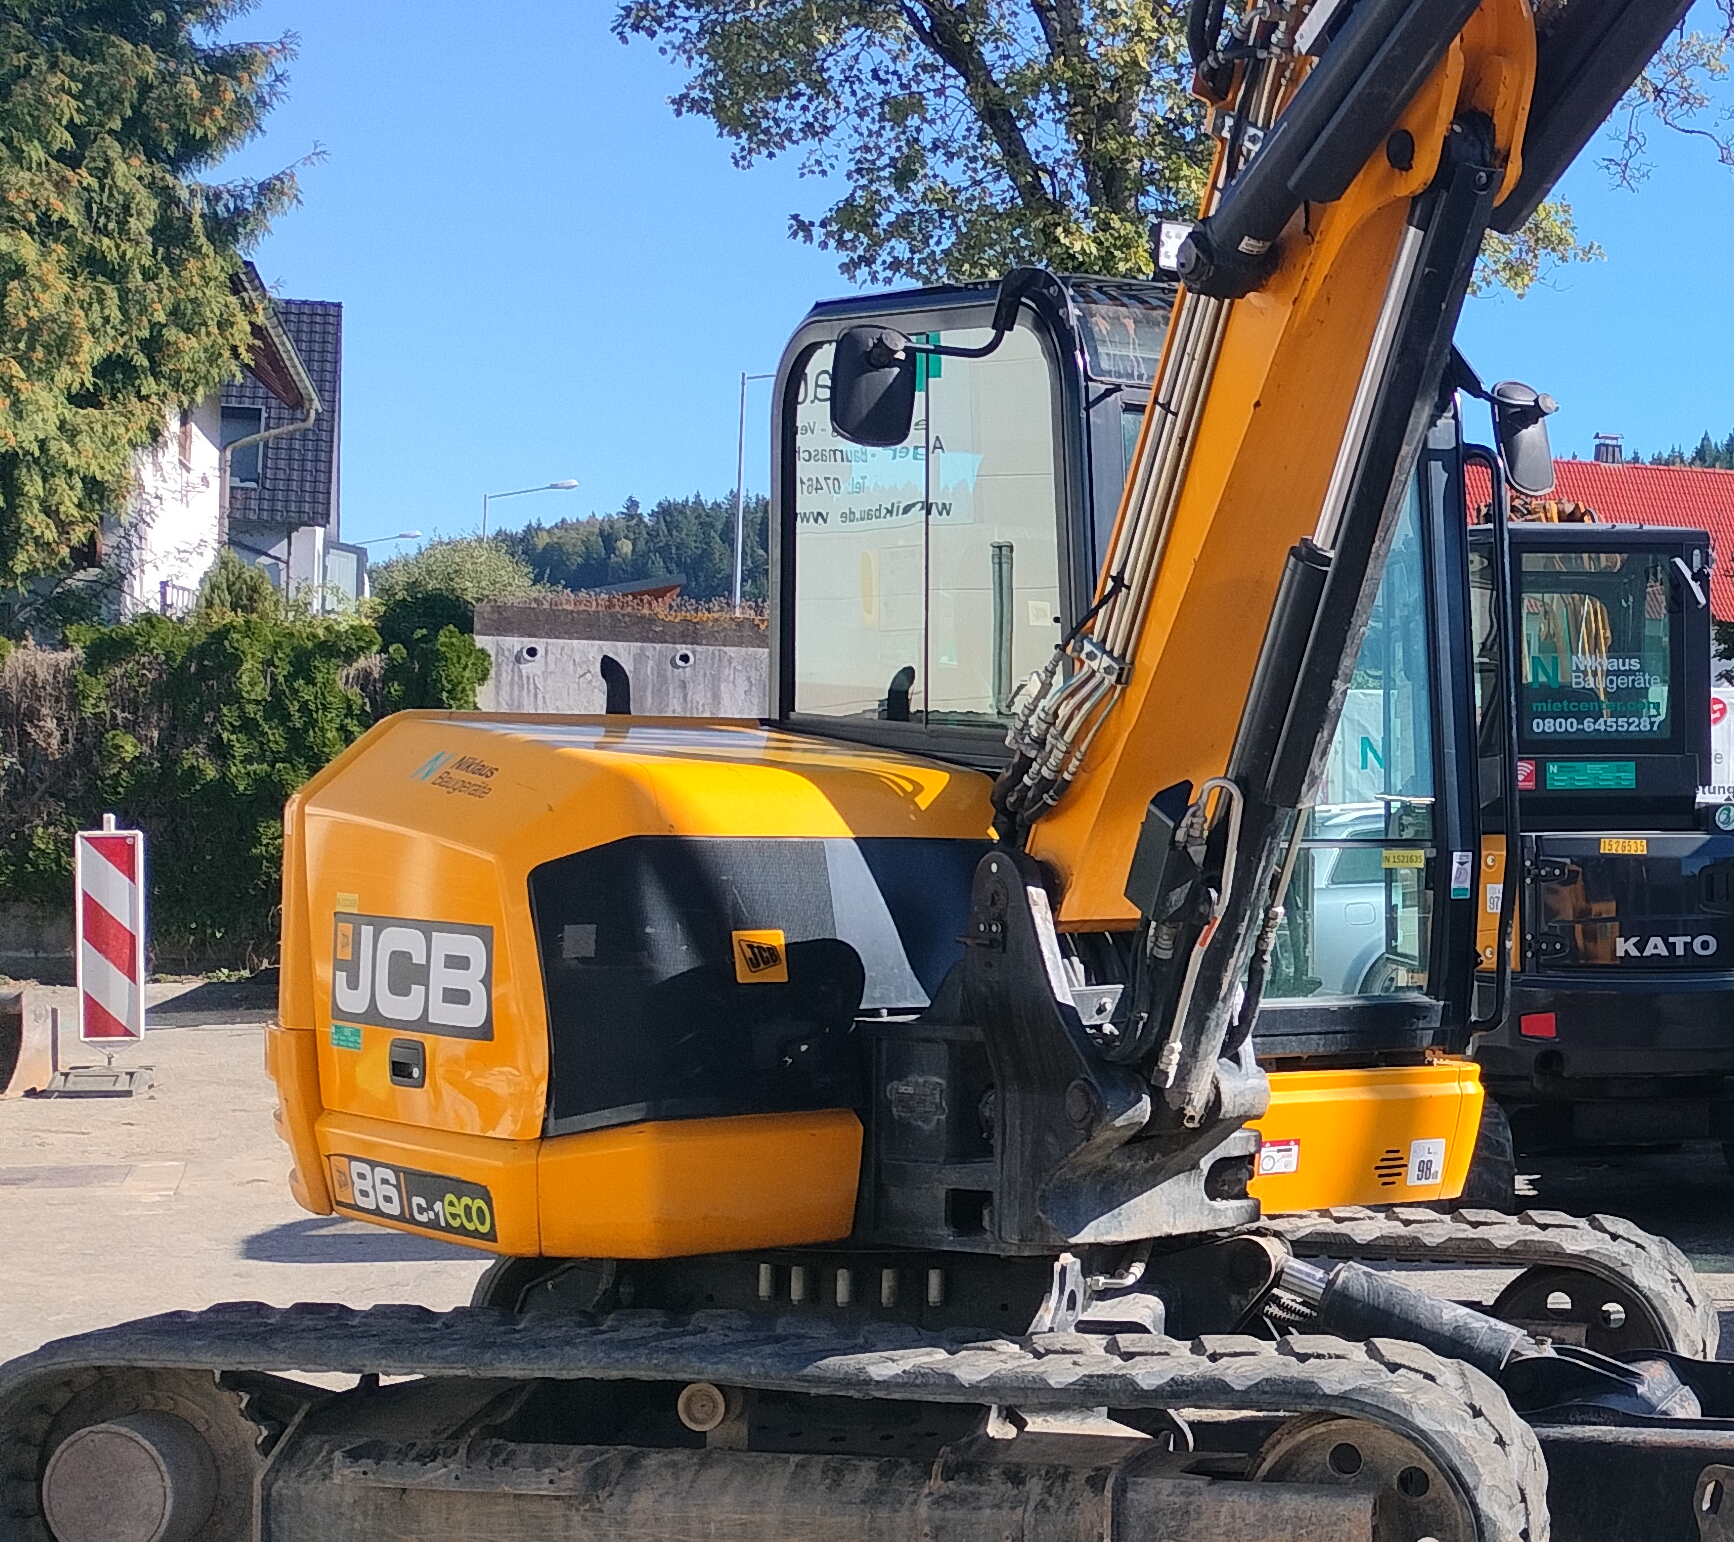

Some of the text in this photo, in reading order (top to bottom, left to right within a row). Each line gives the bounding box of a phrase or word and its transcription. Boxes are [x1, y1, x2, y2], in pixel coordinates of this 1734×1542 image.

[1571, 654, 1641, 671] Niklaus
[1571, 672, 1661, 693] Baugeräte
[1532, 717, 1660, 734] 0800-6455287
[450, 755, 499, 779] Niklaus
[430, 770, 492, 799] Baugeräte
[1602, 840, 1646, 853] 1526535
[745, 943, 779, 969] JCB
[1615, 934, 1718, 958] KATO
[335, 924, 488, 1028] JCB
[1416, 1159, 1433, 1180] 98
[350, 1160, 401, 1216] 86
